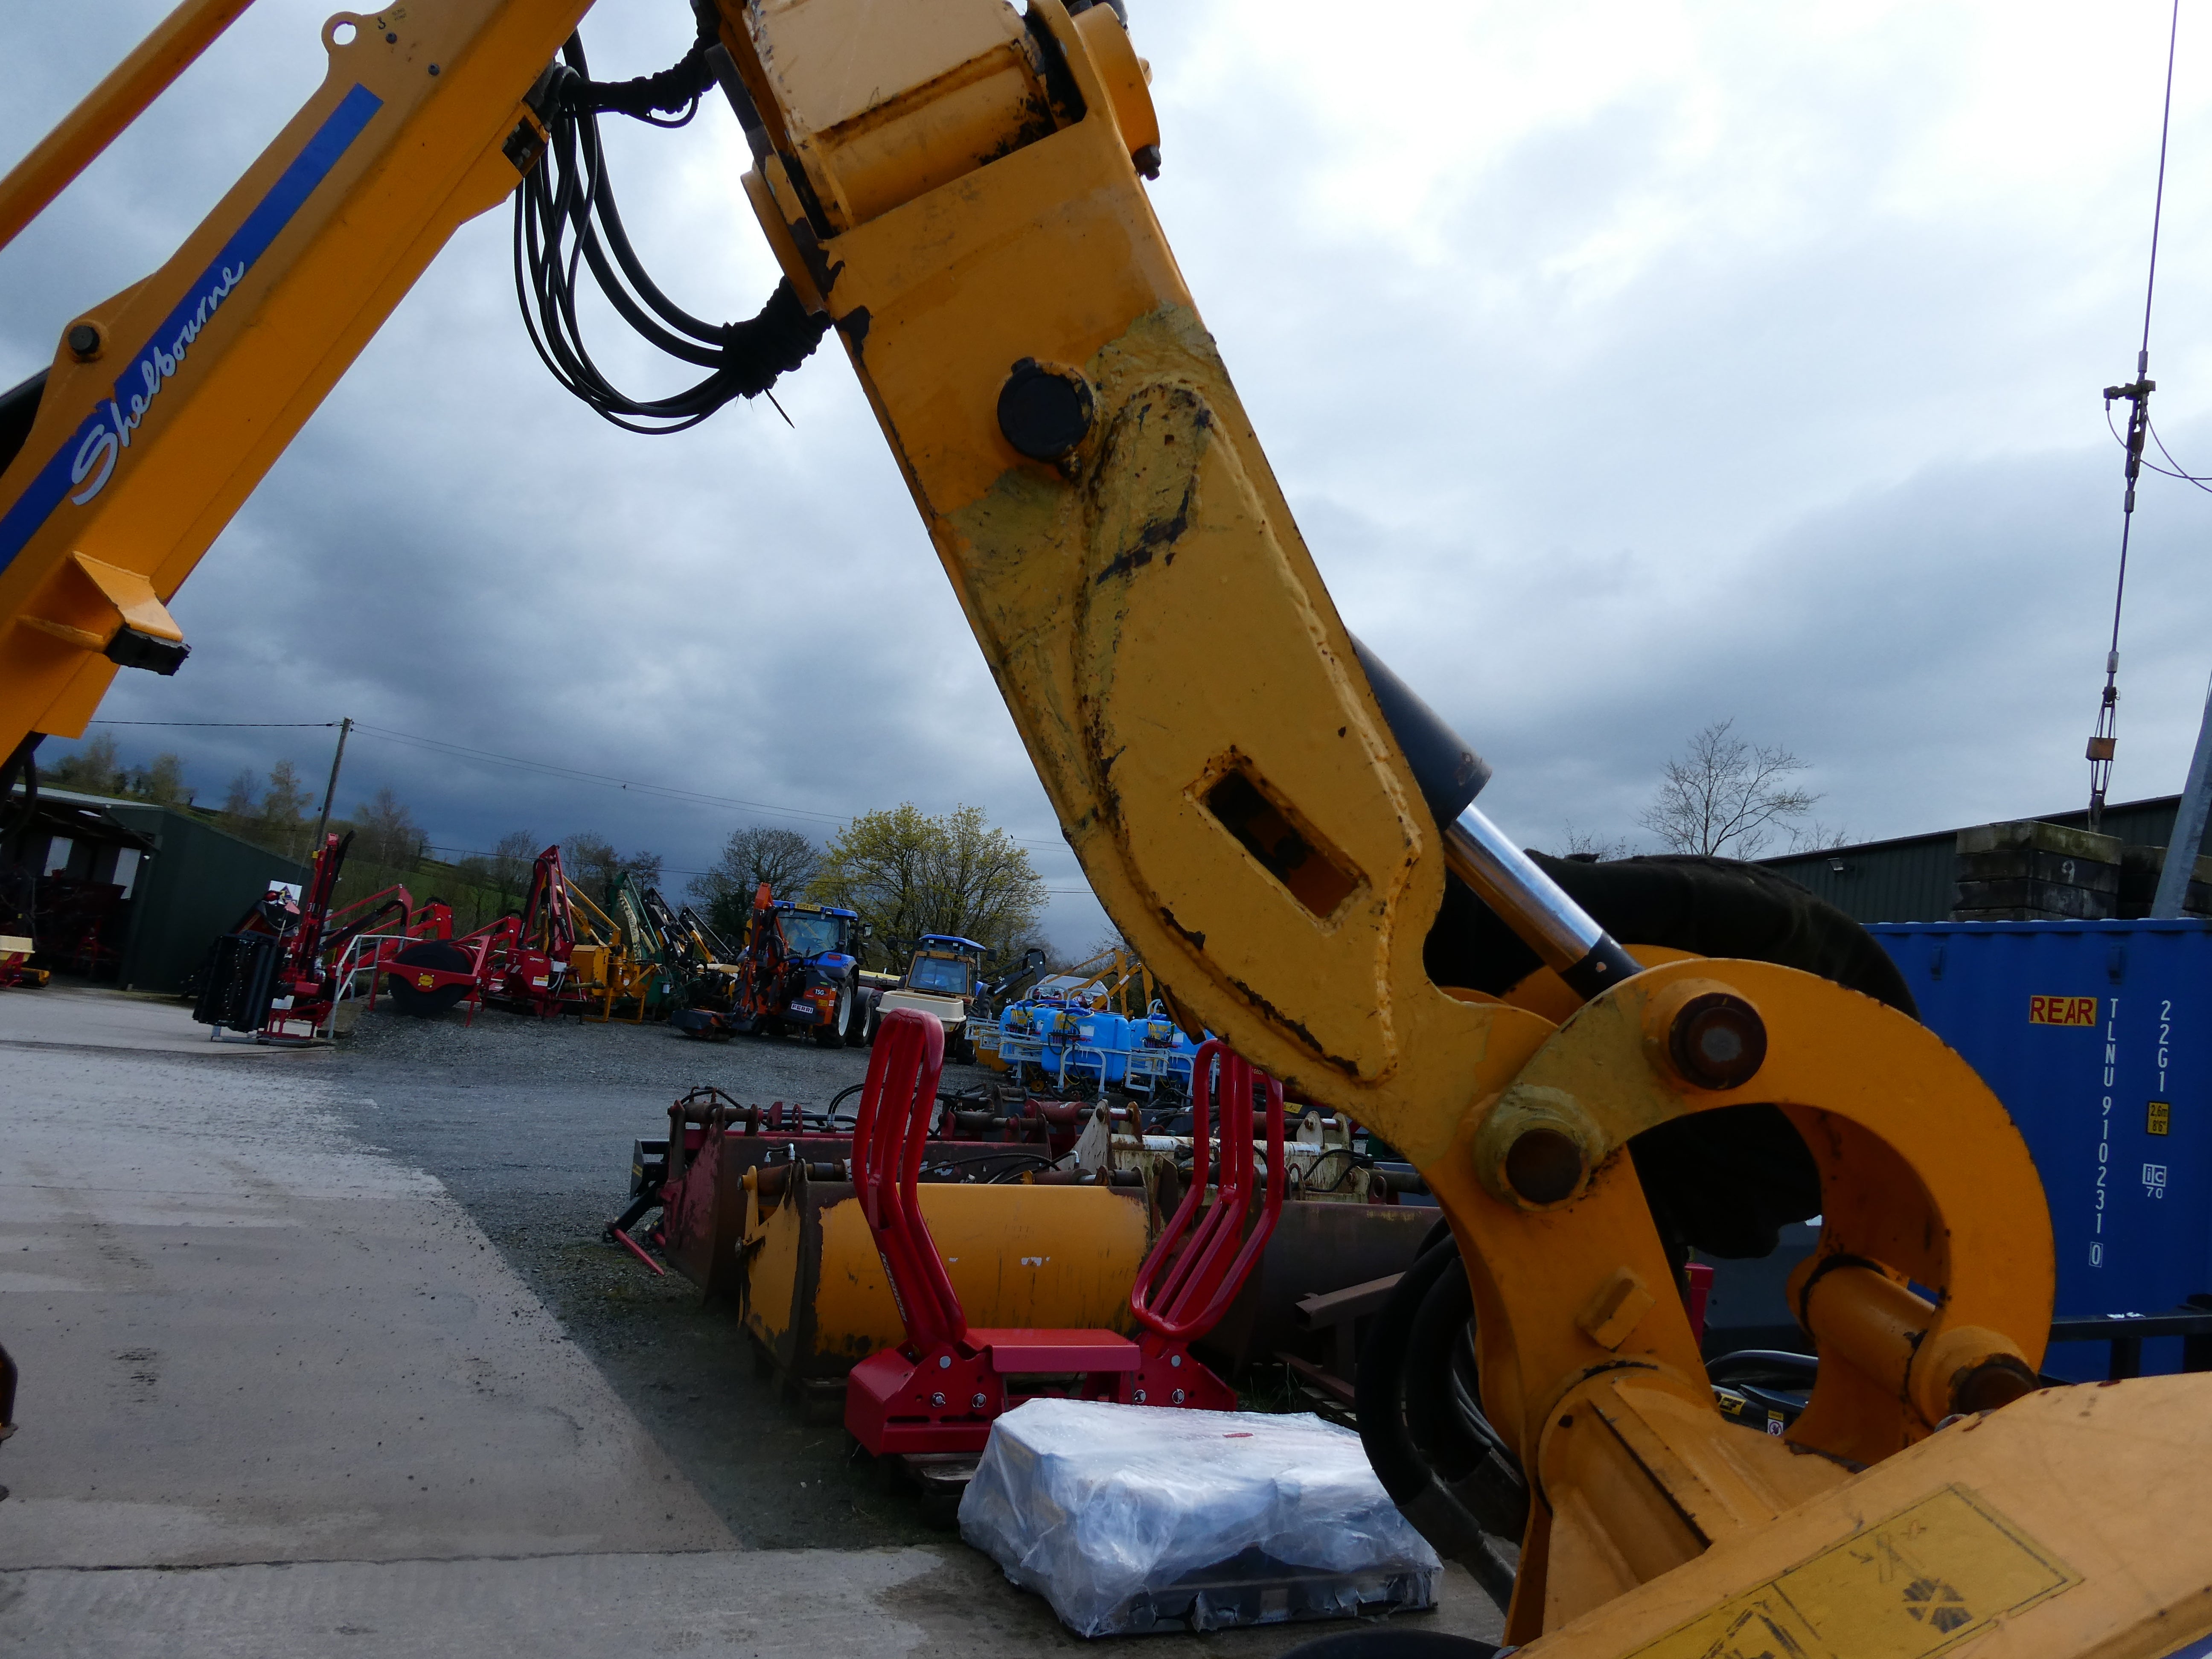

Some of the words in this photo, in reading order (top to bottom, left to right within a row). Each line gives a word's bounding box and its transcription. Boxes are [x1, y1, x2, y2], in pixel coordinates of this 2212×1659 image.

[71, 261, 244, 506] Shelbourne
[2061, 860, 2076, 884] 9
[792, 1004, 813, 1013] FERRI
[2030, 997, 2093, 1025] REAR
[2104, 998, 2119, 1087] TLNU
[2157, 1000, 2171, 1092] 22G1
[2095, 1096, 2112, 1234] 910231
[2146, 1186, 2164, 1199] 70
[2091, 1243, 2102, 1266] 0
